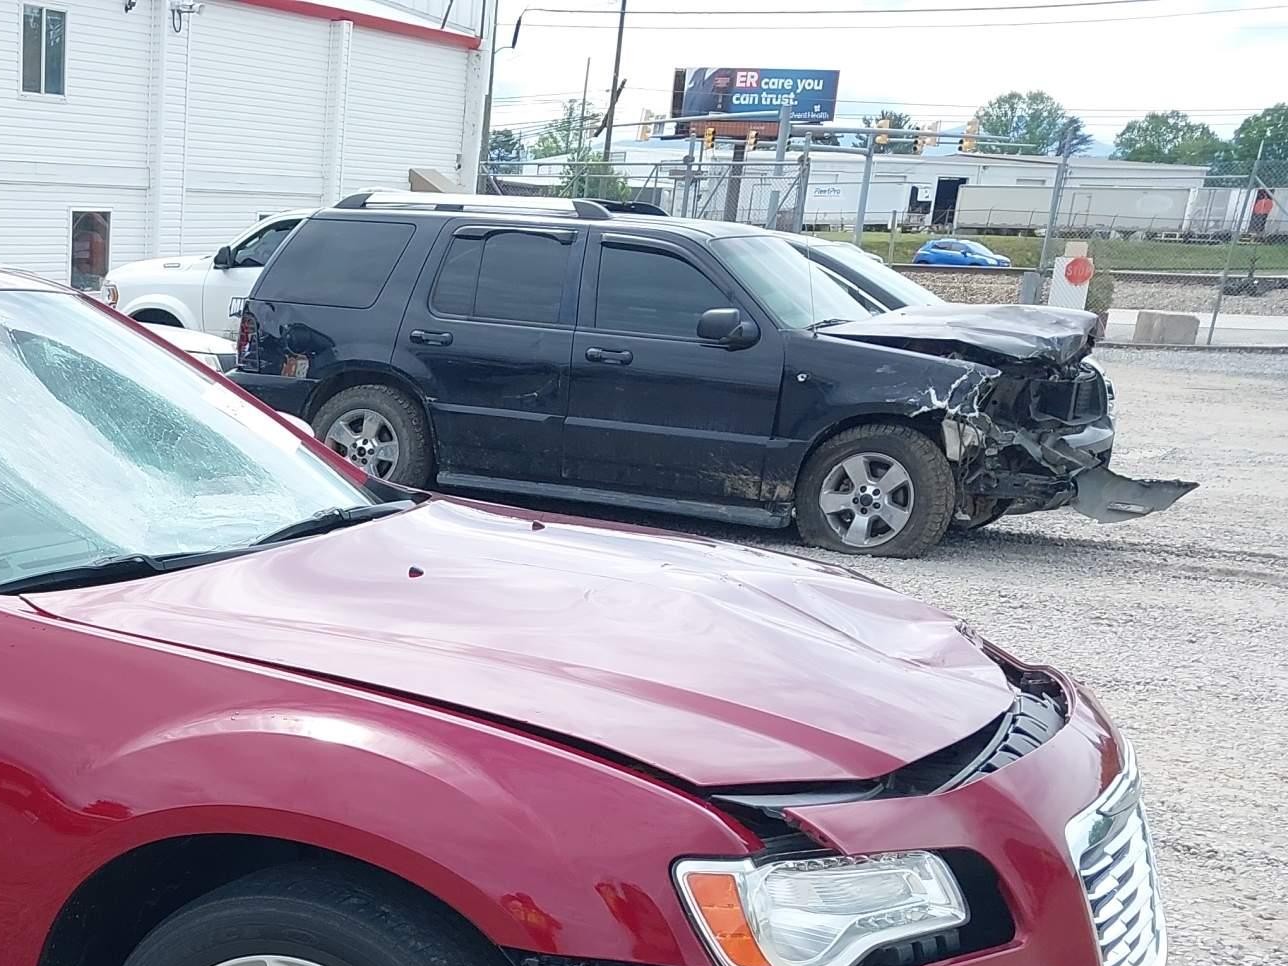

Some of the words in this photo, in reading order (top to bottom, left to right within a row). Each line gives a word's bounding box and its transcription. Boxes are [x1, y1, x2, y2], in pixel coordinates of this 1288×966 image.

[735, 72, 758, 88] ER
[762, 77, 793, 89] care
[796, 79, 824, 92] you
[732, 93, 758, 105] can
[761, 92, 798, 105] trust.
[1066, 264, 1092, 277] STOP
